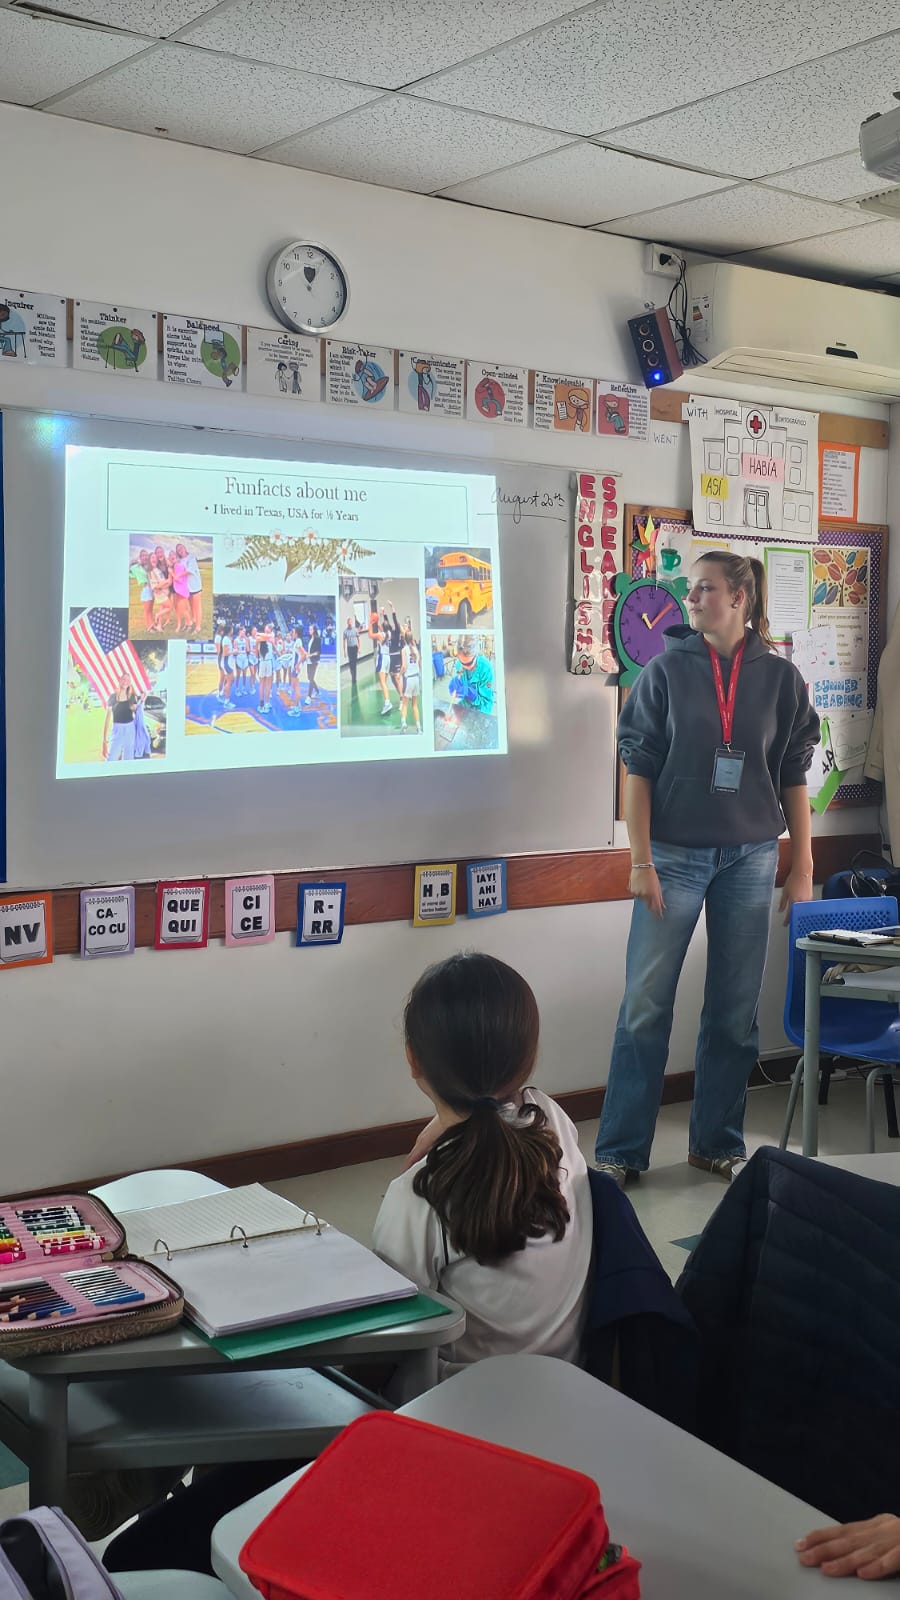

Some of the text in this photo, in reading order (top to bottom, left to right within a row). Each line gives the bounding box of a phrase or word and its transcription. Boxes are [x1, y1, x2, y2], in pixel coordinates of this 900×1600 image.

[100, 313, 127, 324] Thinker
[186, 320, 220, 332] Balanced
[278, 337, 299, 348] Caring
[482, 369, 518, 380] Open-minded
[543, 375, 584, 388] Knowledgeable
[611, 385, 637, 394] Reflective
[687, 407, 708, 420] WITH
[654, 432, 679, 445] WENT
[749, 458, 777, 478] HABÍA
[224, 476, 368, 502] Funfacts about me
[706, 478, 723, 496] ASÍ
[213, 504, 218, 514] I
[220, 504, 242, 516] lived
[244, 506, 254, 516] in
[255, 506, 285, 519] Texas,
[287, 508, 309, 519] USA
[311, 509, 323, 519] for
[336, 511, 359, 521] Years
[577, 474, 596, 652] ENGLISH
[815, 694, 863, 708] READING
[167, 899, 200, 913] QUE
[243, 895, 261, 911] CI
[478, 897, 497, 907] HAY
[88, 922, 126, 936] CO CU
[168, 919, 197, 934] QUI
[240, 915, 263, 931] CE
[311, 919, 333, 934] RR
[4, 922, 41, 946] NV
